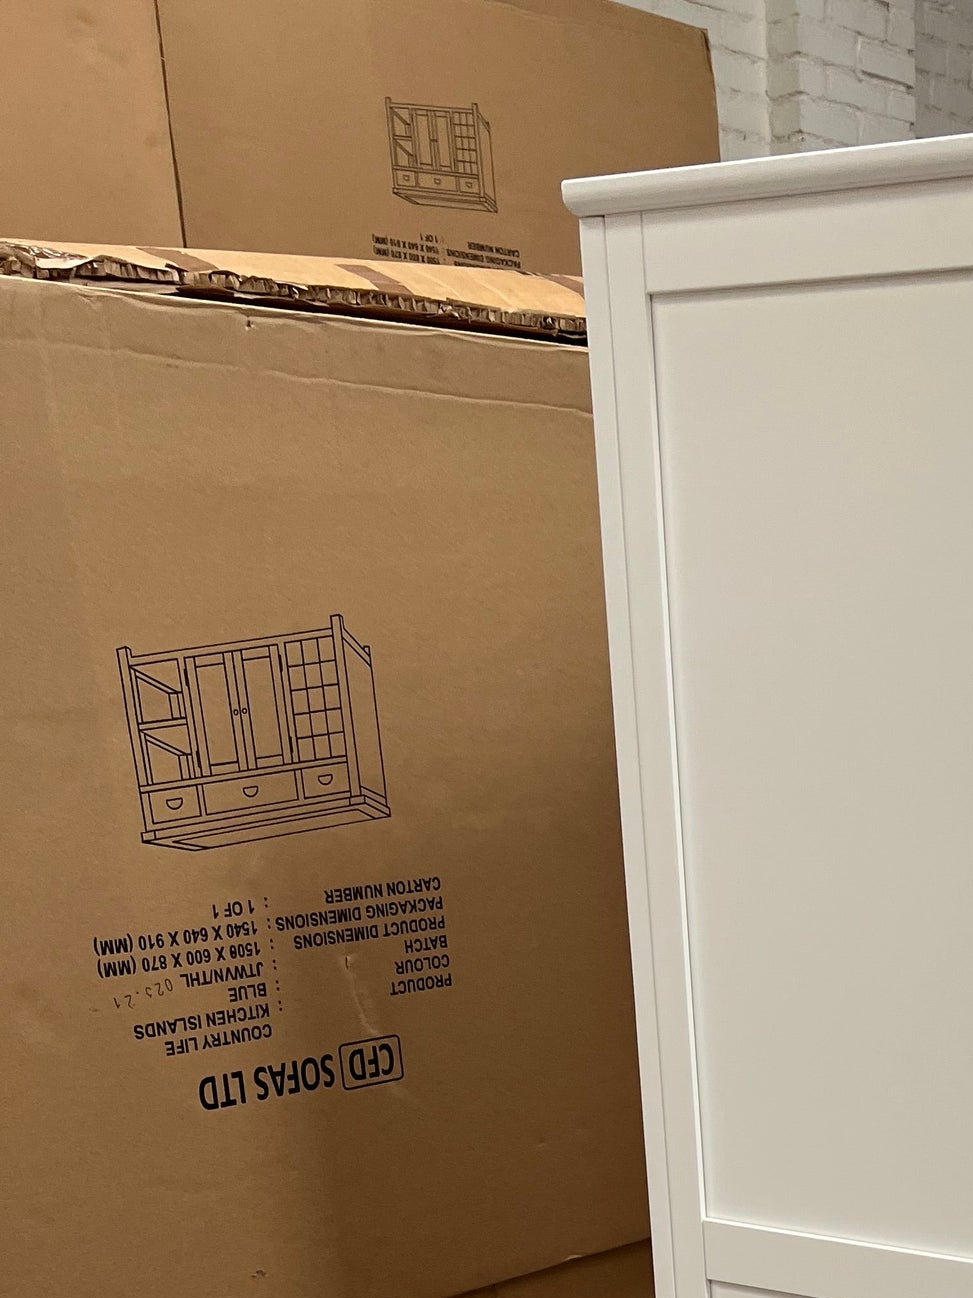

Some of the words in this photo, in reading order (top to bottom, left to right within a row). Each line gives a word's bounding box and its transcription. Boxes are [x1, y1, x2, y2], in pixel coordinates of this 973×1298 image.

[324, 883, 382, 904] NUMBER
[386, 877, 441, 896] CARTON
[212, 905, 219, 919] 1
[224, 901, 243, 917] OF
[248, 900, 255, 914] 1
[365, 896, 443, 919] PACKAGING
[226, 920, 258, 937] 1540
[275, 906, 361, 932] DIMENSIONS
[383, 916, 445, 936] PRODUCT
[138, 933, 164, 951] 910
[168, 931, 178, 946] X
[183, 927, 208, 944] 640
[212, 925, 222, 940] X
[293, 924, 378, 949] DIMENSIONS
[93, 934, 133, 956] (MM)
[215, 946, 225, 961] X
[404, 935, 447, 953] BATCH
[97, 956, 136, 978] (MM)
[142, 955, 167, 972] 870
[171, 953, 181, 967] X
[186, 949, 211, 966] 600
[394, 954, 449, 975] COLOUR
[180, 962, 263, 988] JTWVN/THL
[390, 973, 452, 995] PRODUCT
[228, 982, 267, 1002] BLUE
[206, 1003, 270, 1027] KITCHEN
[133, 1015, 201, 1040] ISLANDS
[202, 1024, 272, 1050] COUNTRY
[164, 1037, 198, 1056] LIFE
[349, 1043, 394, 1080] CFD
[254, 1054, 335, 1101] SOFAS
[199, 1071, 246, 1110] LTD
